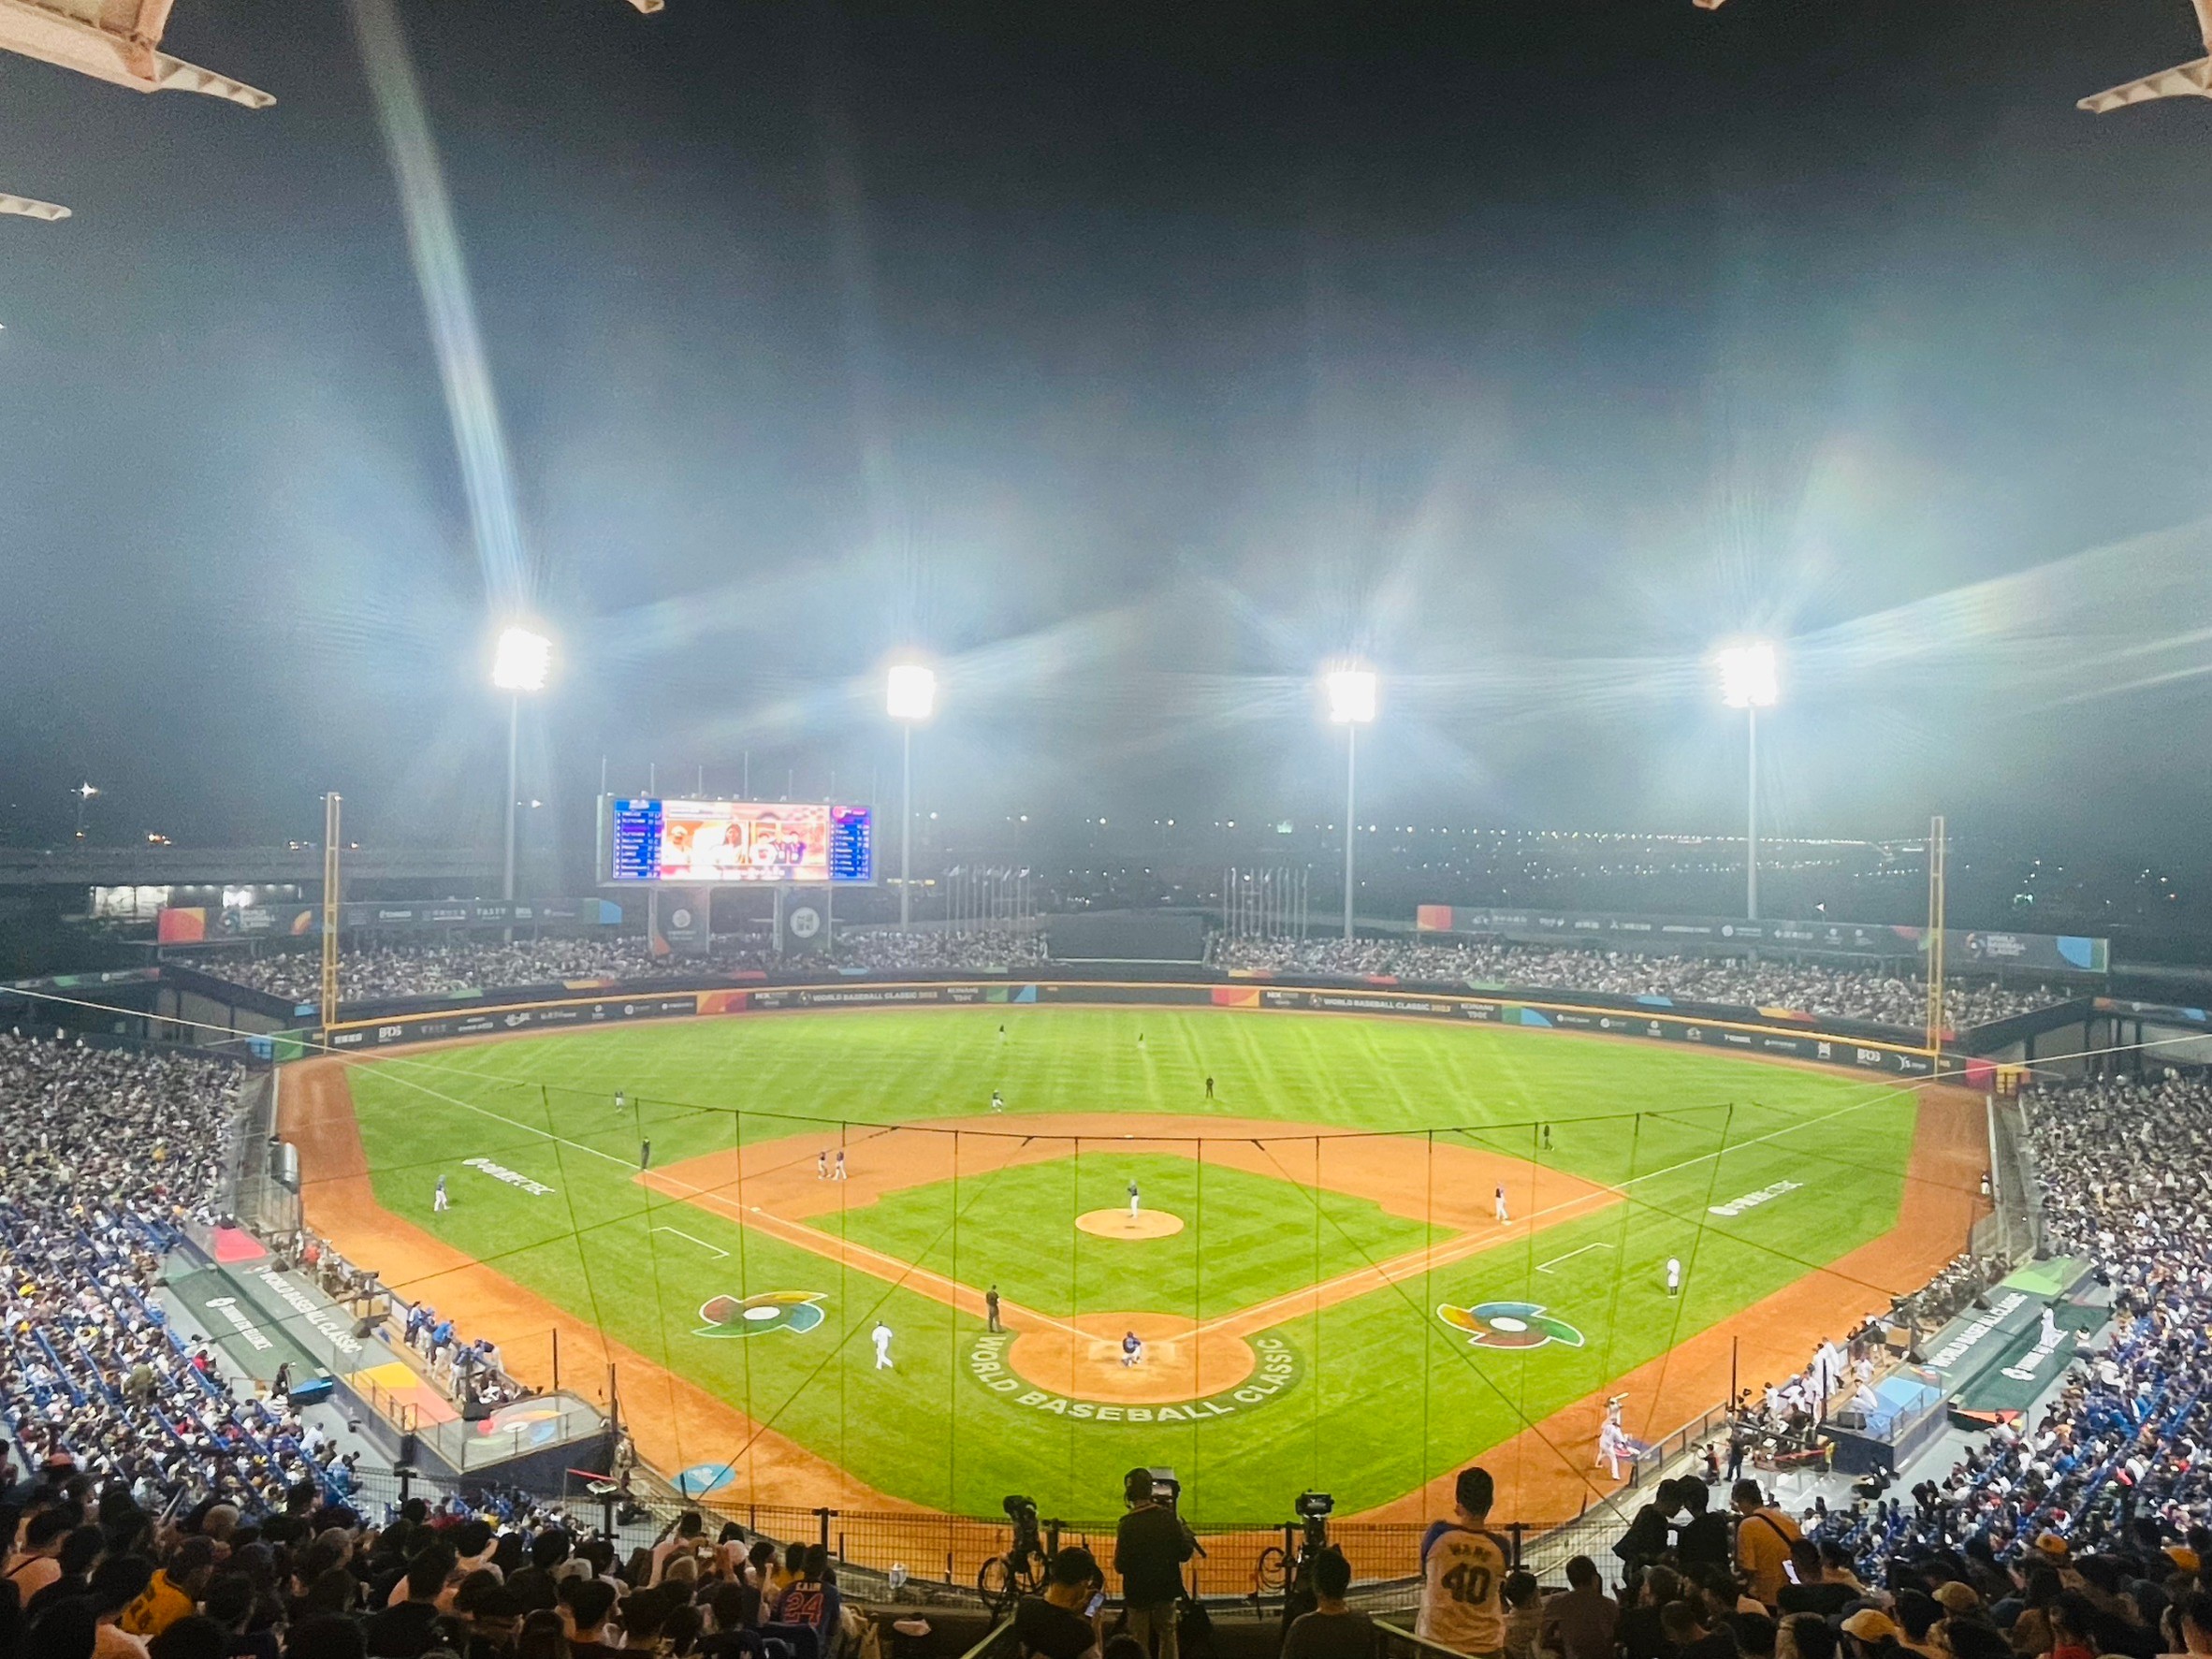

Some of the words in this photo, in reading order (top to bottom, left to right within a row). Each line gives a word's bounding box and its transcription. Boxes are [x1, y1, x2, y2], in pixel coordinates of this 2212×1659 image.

[1324, 997, 1353, 1007] WORLD
[1354, 999, 1395, 1010] BASEBALL
[1395, 1002, 1430, 1011] CLASSIC
[970, 1335, 1020, 1392] WORLD
[1014, 1390, 1235, 1423] BASEBALL
[1233, 1337, 1294, 1404] CLASSIC
[1441, 1562, 1492, 1606] 40
[784, 1591, 824, 1627] 24
